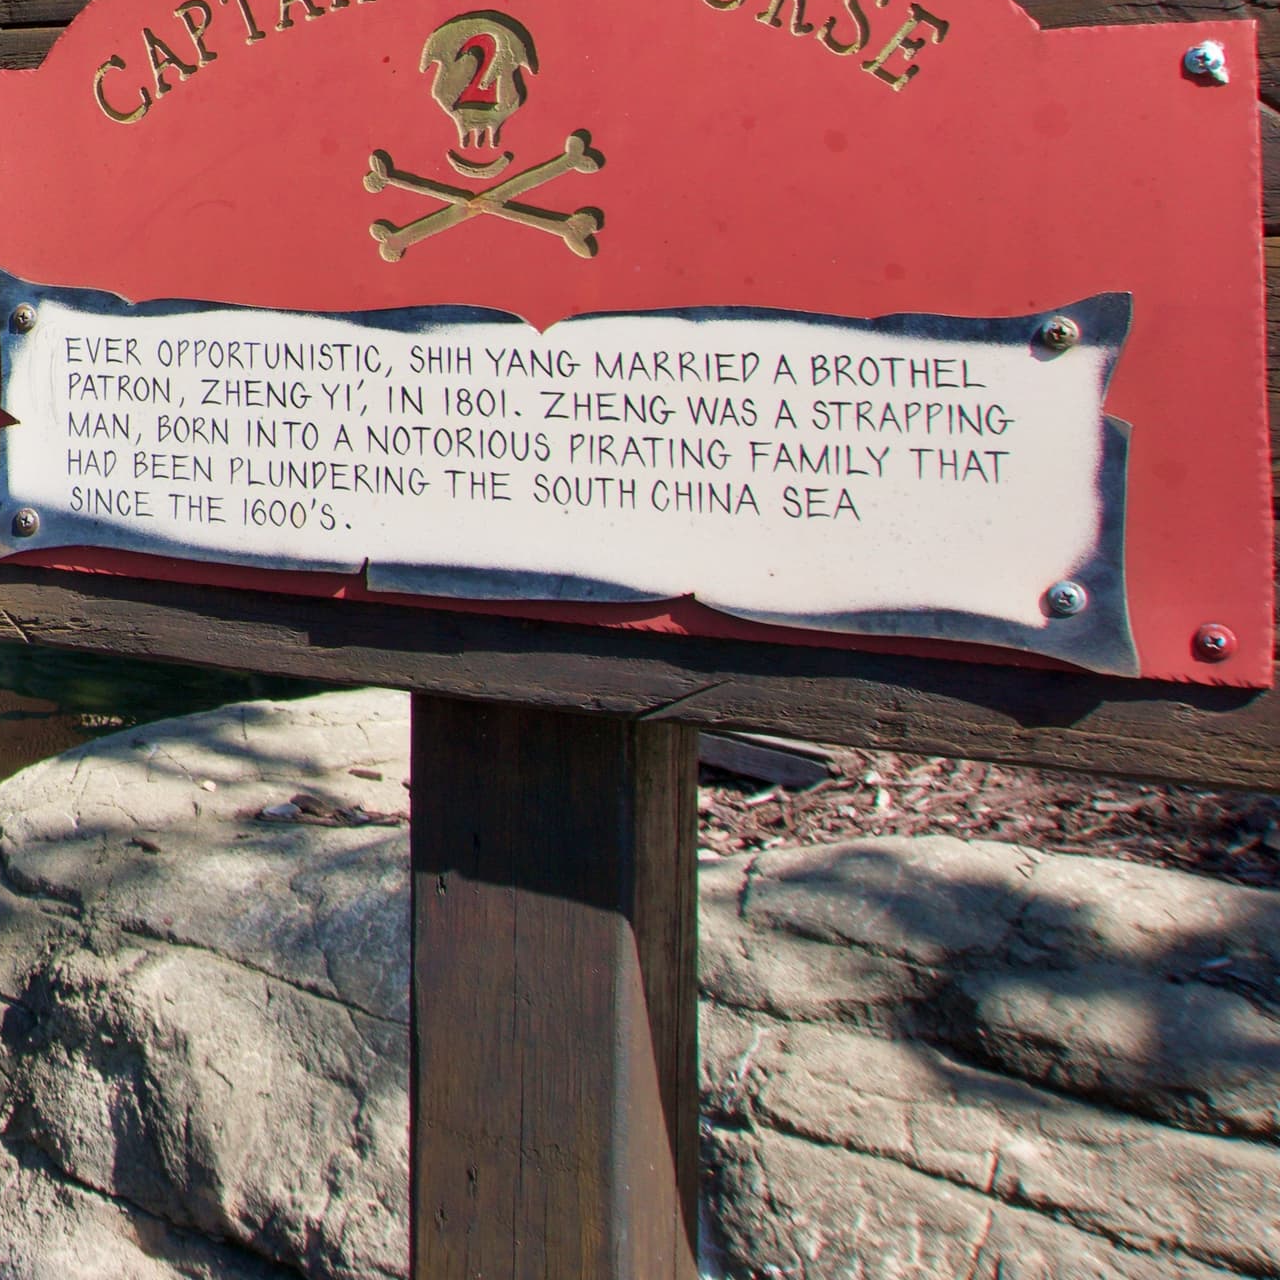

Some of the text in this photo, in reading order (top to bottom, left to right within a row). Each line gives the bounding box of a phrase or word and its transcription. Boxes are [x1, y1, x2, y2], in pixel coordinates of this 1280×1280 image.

[453, 32, 500, 111] 2
[66, 337, 986, 388] EVER OPPORTUNISTIC, SHIH YANG MARRIED A BROTHEL
[67, 373, 185, 408] PATRON,
[201, 378, 313, 408] ZHENG
[388, 386, 423, 416] IN
[444, 387, 522, 418] 1801.
[539, 391, 676, 425] ZHENG
[687, 396, 758, 427] WAS
[774, 399, 797, 429] A
[812, 400, 1016, 435] STRAPPING
[67, 412, 1010, 483] MAN, BORN INTO A NOTORIOUS PIRATING FAMILY THAT
[66, 450, 860, 520] HAD BEEN PLUNDERING THE SOUTH CHINA SEA
[70, 487, 154, 517] SINCE
[168, 494, 226, 523] THE
